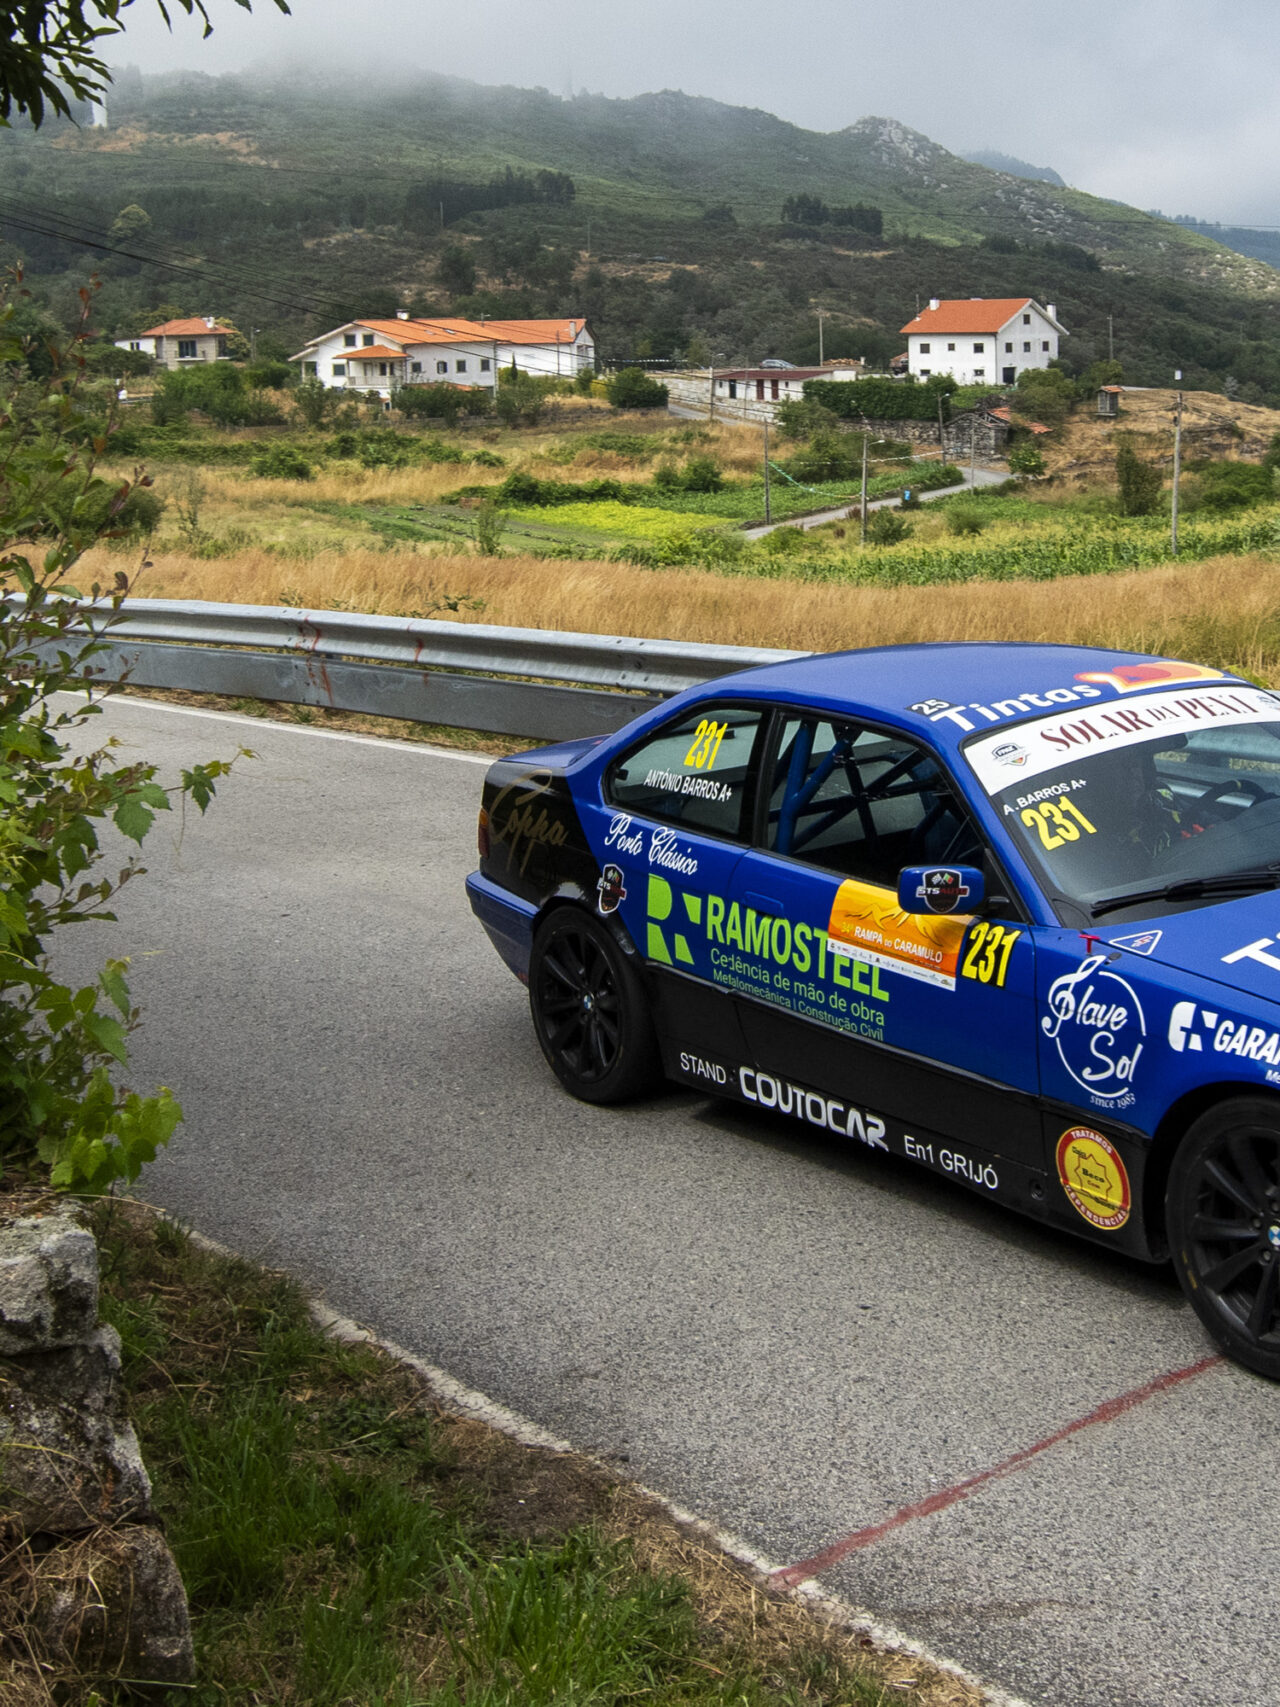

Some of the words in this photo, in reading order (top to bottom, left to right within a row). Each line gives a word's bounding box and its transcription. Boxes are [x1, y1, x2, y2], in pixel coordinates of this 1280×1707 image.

[911, 699, 950, 716] 25
[930, 684, 1102, 731] Tintas
[1040, 709, 1154, 752] SOLAR
[683, 719, 728, 770] 231
[643, 767, 682, 792] ANTÓNIO
[681, 776, 720, 800] BARROS
[717, 783, 732, 802] A+
[1017, 781, 1071, 809] BARROS
[1070, 778, 1087, 790] A+
[604, 813, 643, 856] Porto
[648, 826, 699, 876] Clássico
[1020, 795, 1098, 850] 231
[706, 895, 890, 1002] RAMOSTEEL
[854, 926, 883, 945] RAMPA
[893, 938, 943, 964] CARAMULO
[962, 922, 1021, 987] 231
[710, 948, 770, 984] Cedência
[773, 971, 791, 991] de
[794, 982, 825, 1004] mão
[829, 992, 847, 1012] de
[850, 1003, 885, 1027] obra
[798, 1000, 857, 1032] Construção
[860, 1022, 884, 1041] Civil
[1081, 1031, 1143, 1082] Sol
[680, 1052, 727, 1084] STAND
[739, 1065, 890, 1152] COUTOCAR
[939, 1149, 998, 1189] GRIJÓ
[1090, 1094, 1115, 1109] since
[1070, 1129, 1112, 1154] TRATAMOS
